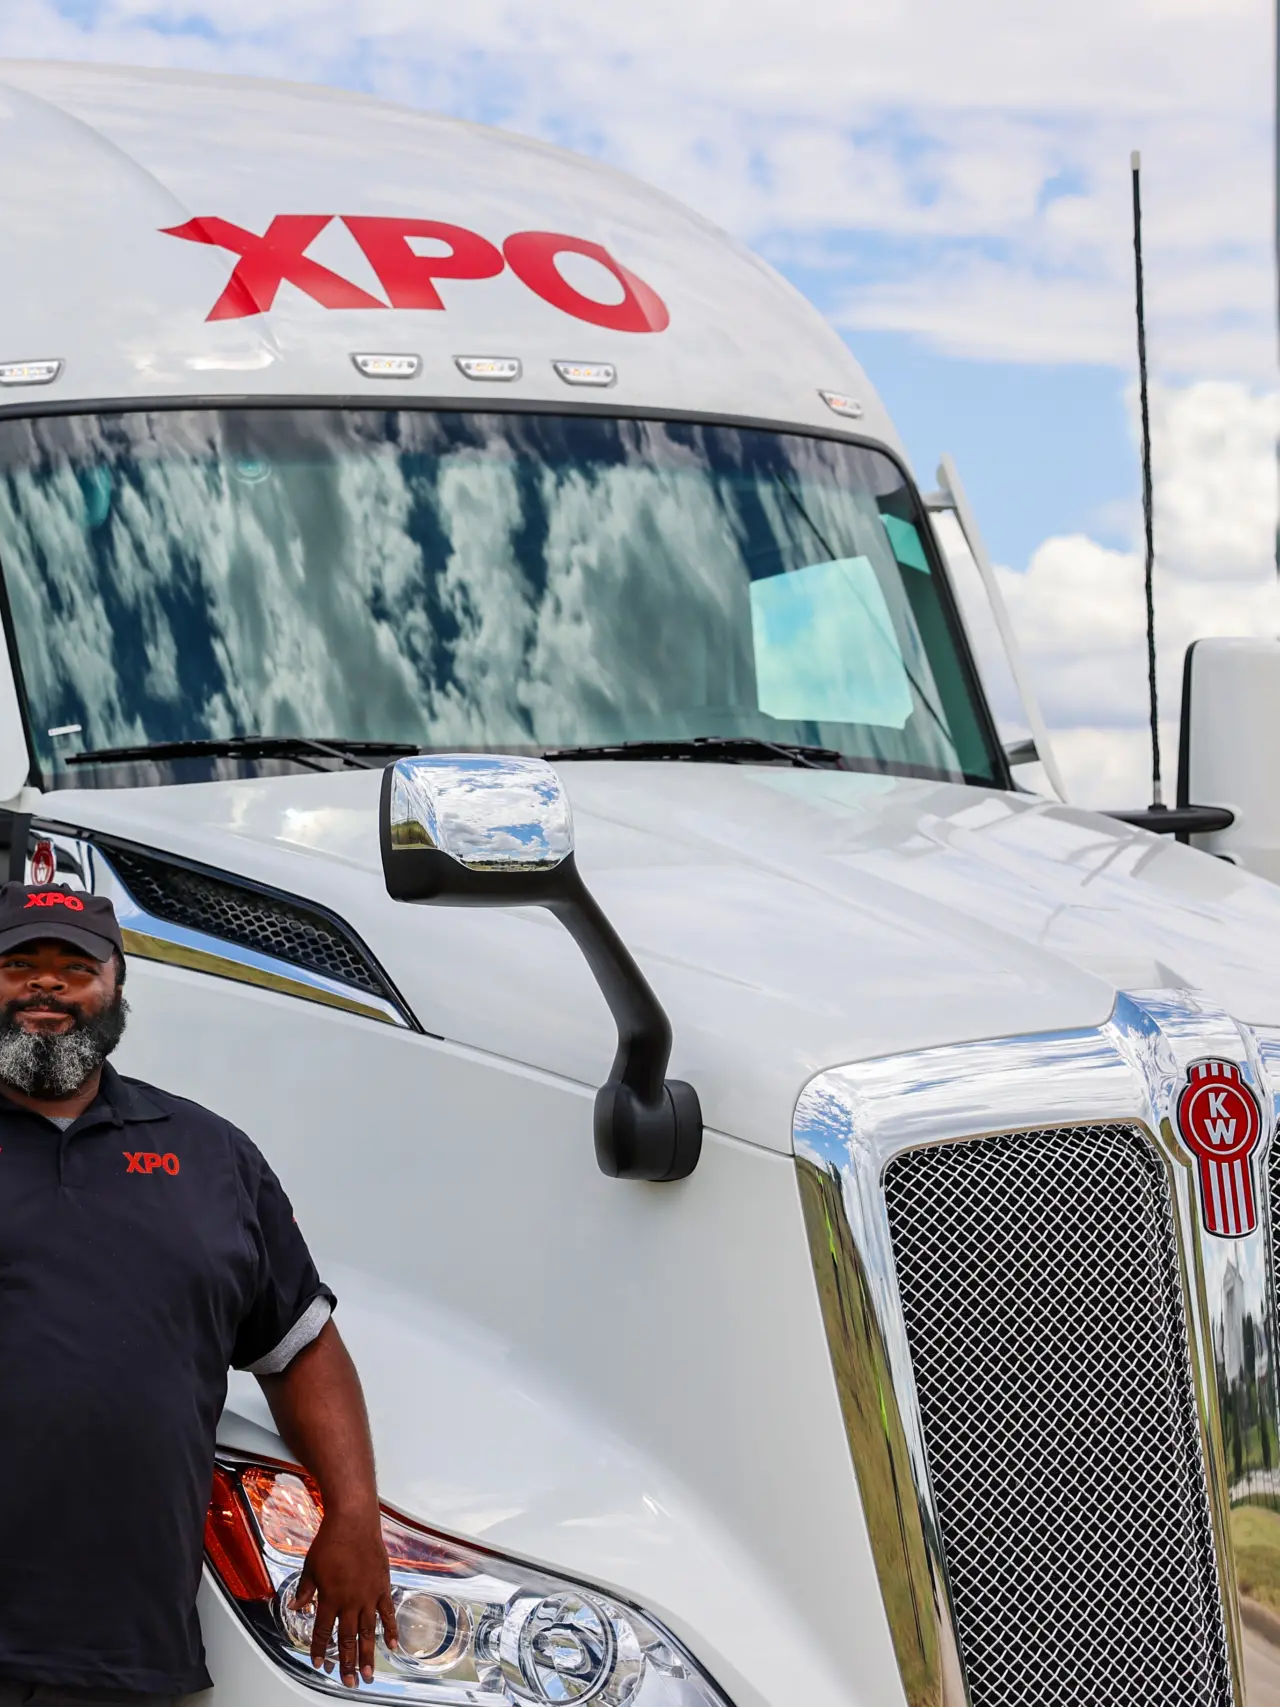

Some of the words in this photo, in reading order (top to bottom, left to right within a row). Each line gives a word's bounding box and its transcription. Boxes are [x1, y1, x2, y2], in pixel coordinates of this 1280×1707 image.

[156, 215, 669, 333] XPO
[23, 891, 84, 911] XPO
[1208, 1092, 1231, 1118] K
[1203, 1118, 1237, 1145] W
[122, 1152, 180, 1176] XPO
